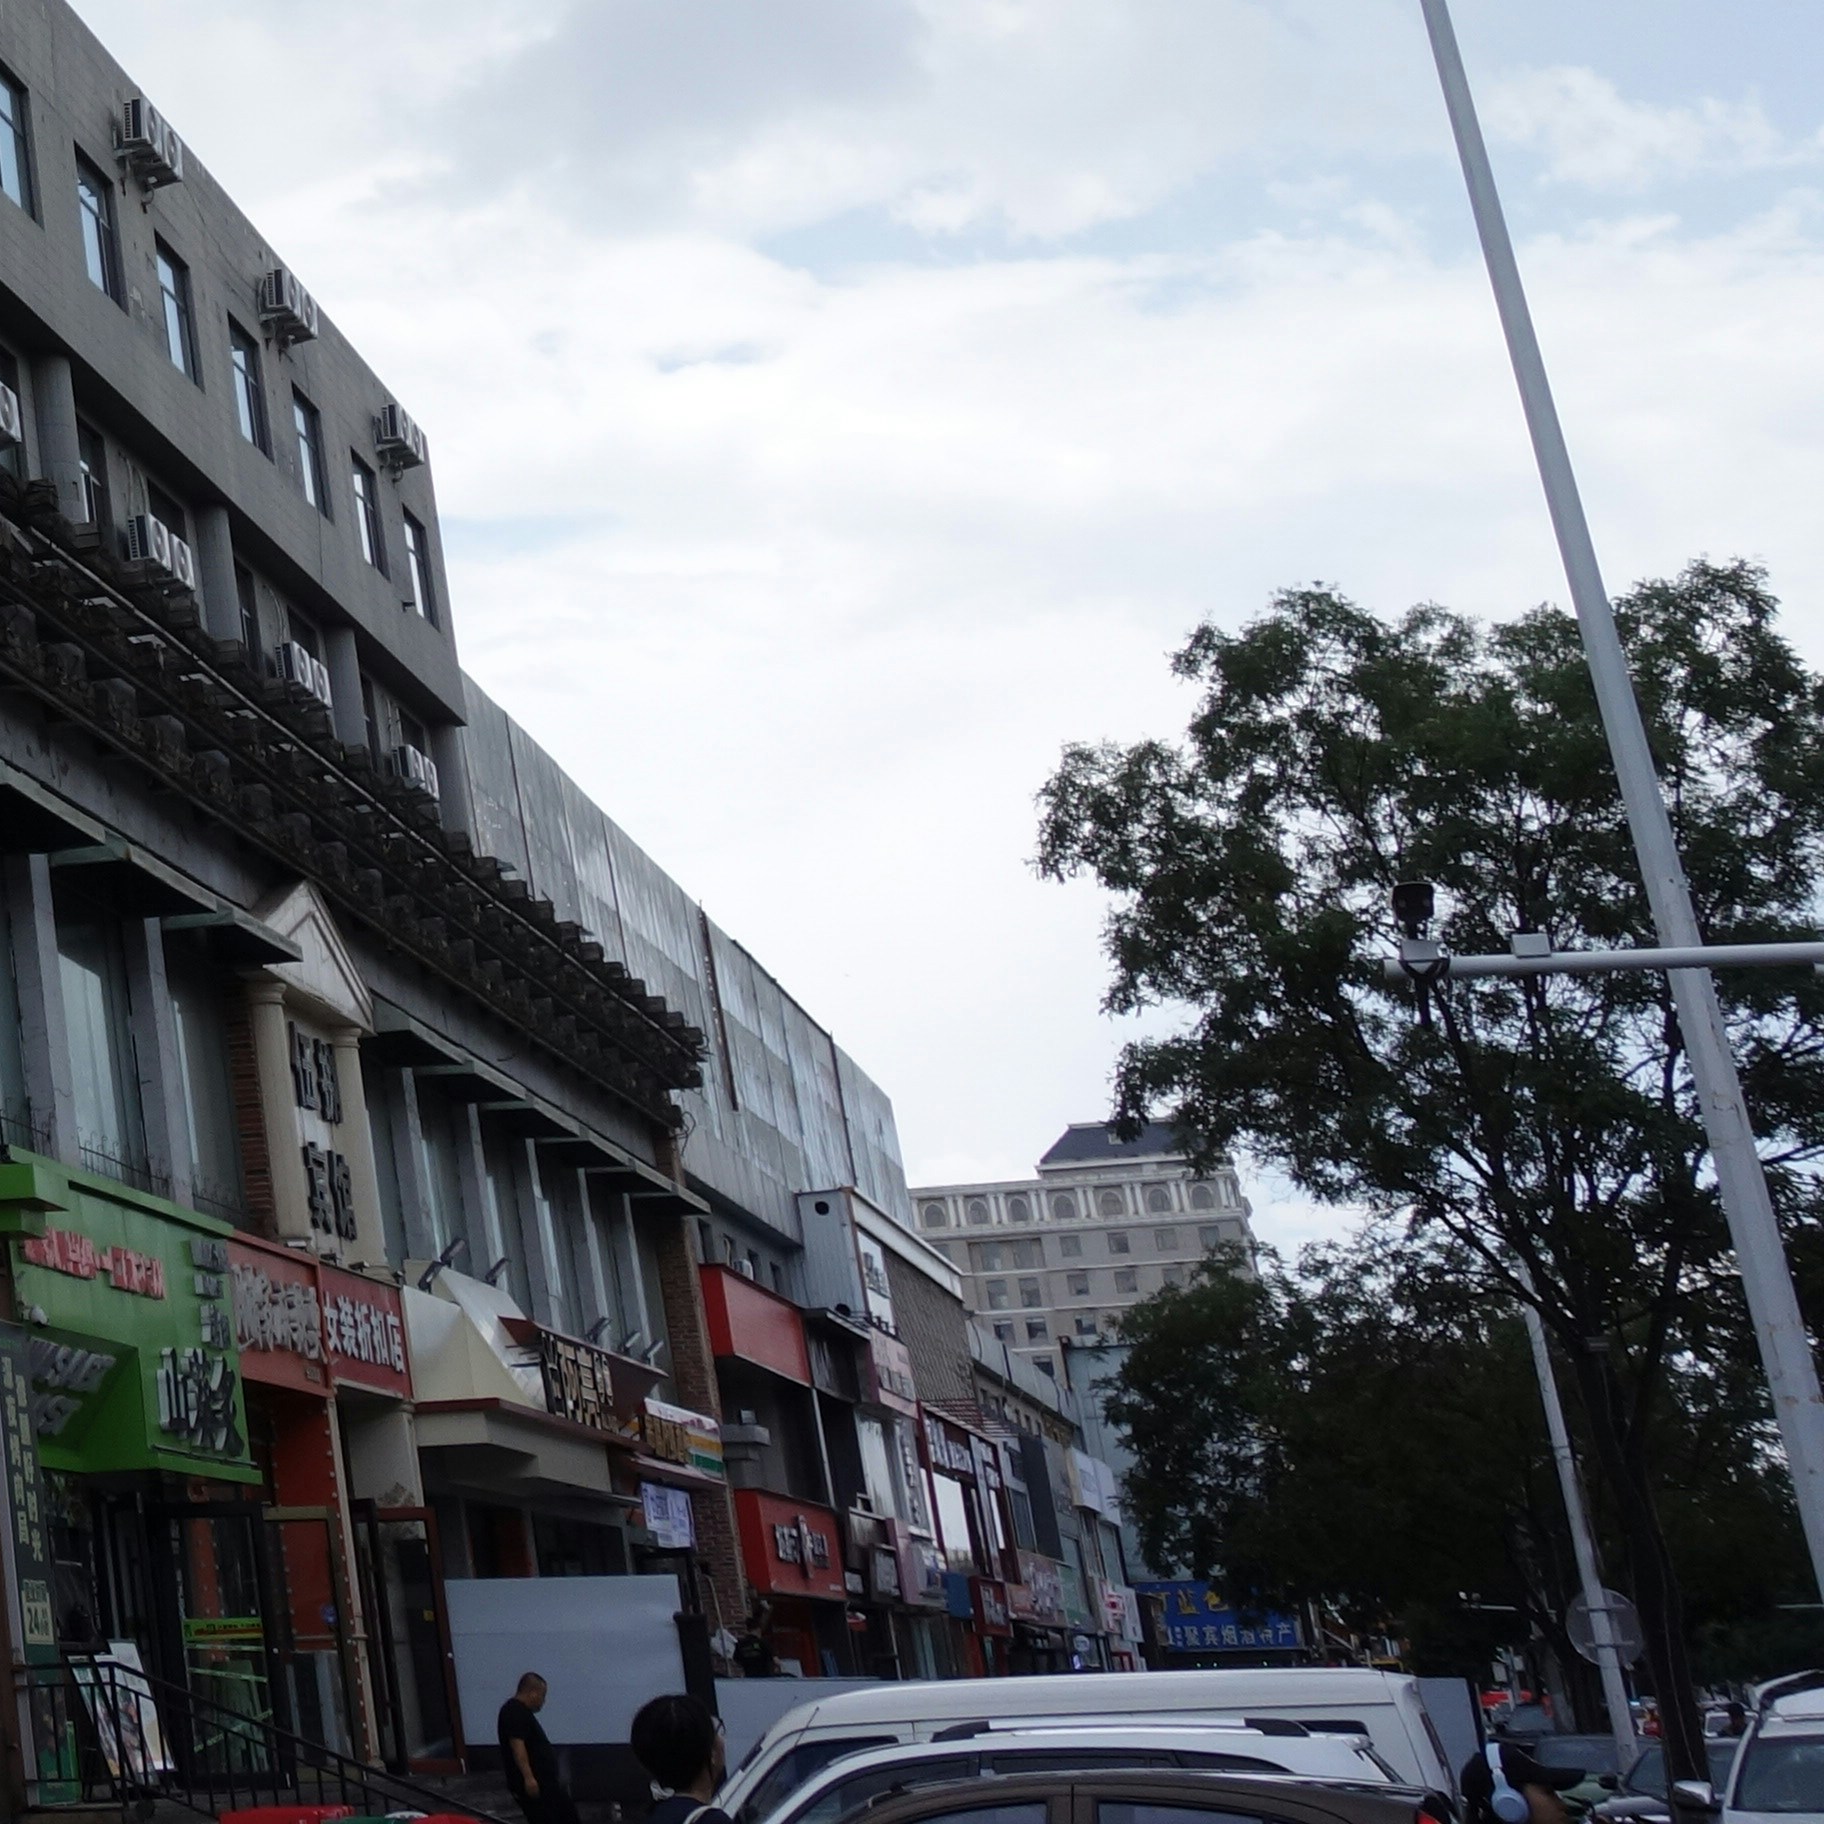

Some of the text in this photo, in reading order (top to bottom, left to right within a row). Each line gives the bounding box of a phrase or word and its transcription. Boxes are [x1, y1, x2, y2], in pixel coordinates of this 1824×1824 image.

[323, 1290, 406, 1374] 女装折扣店
